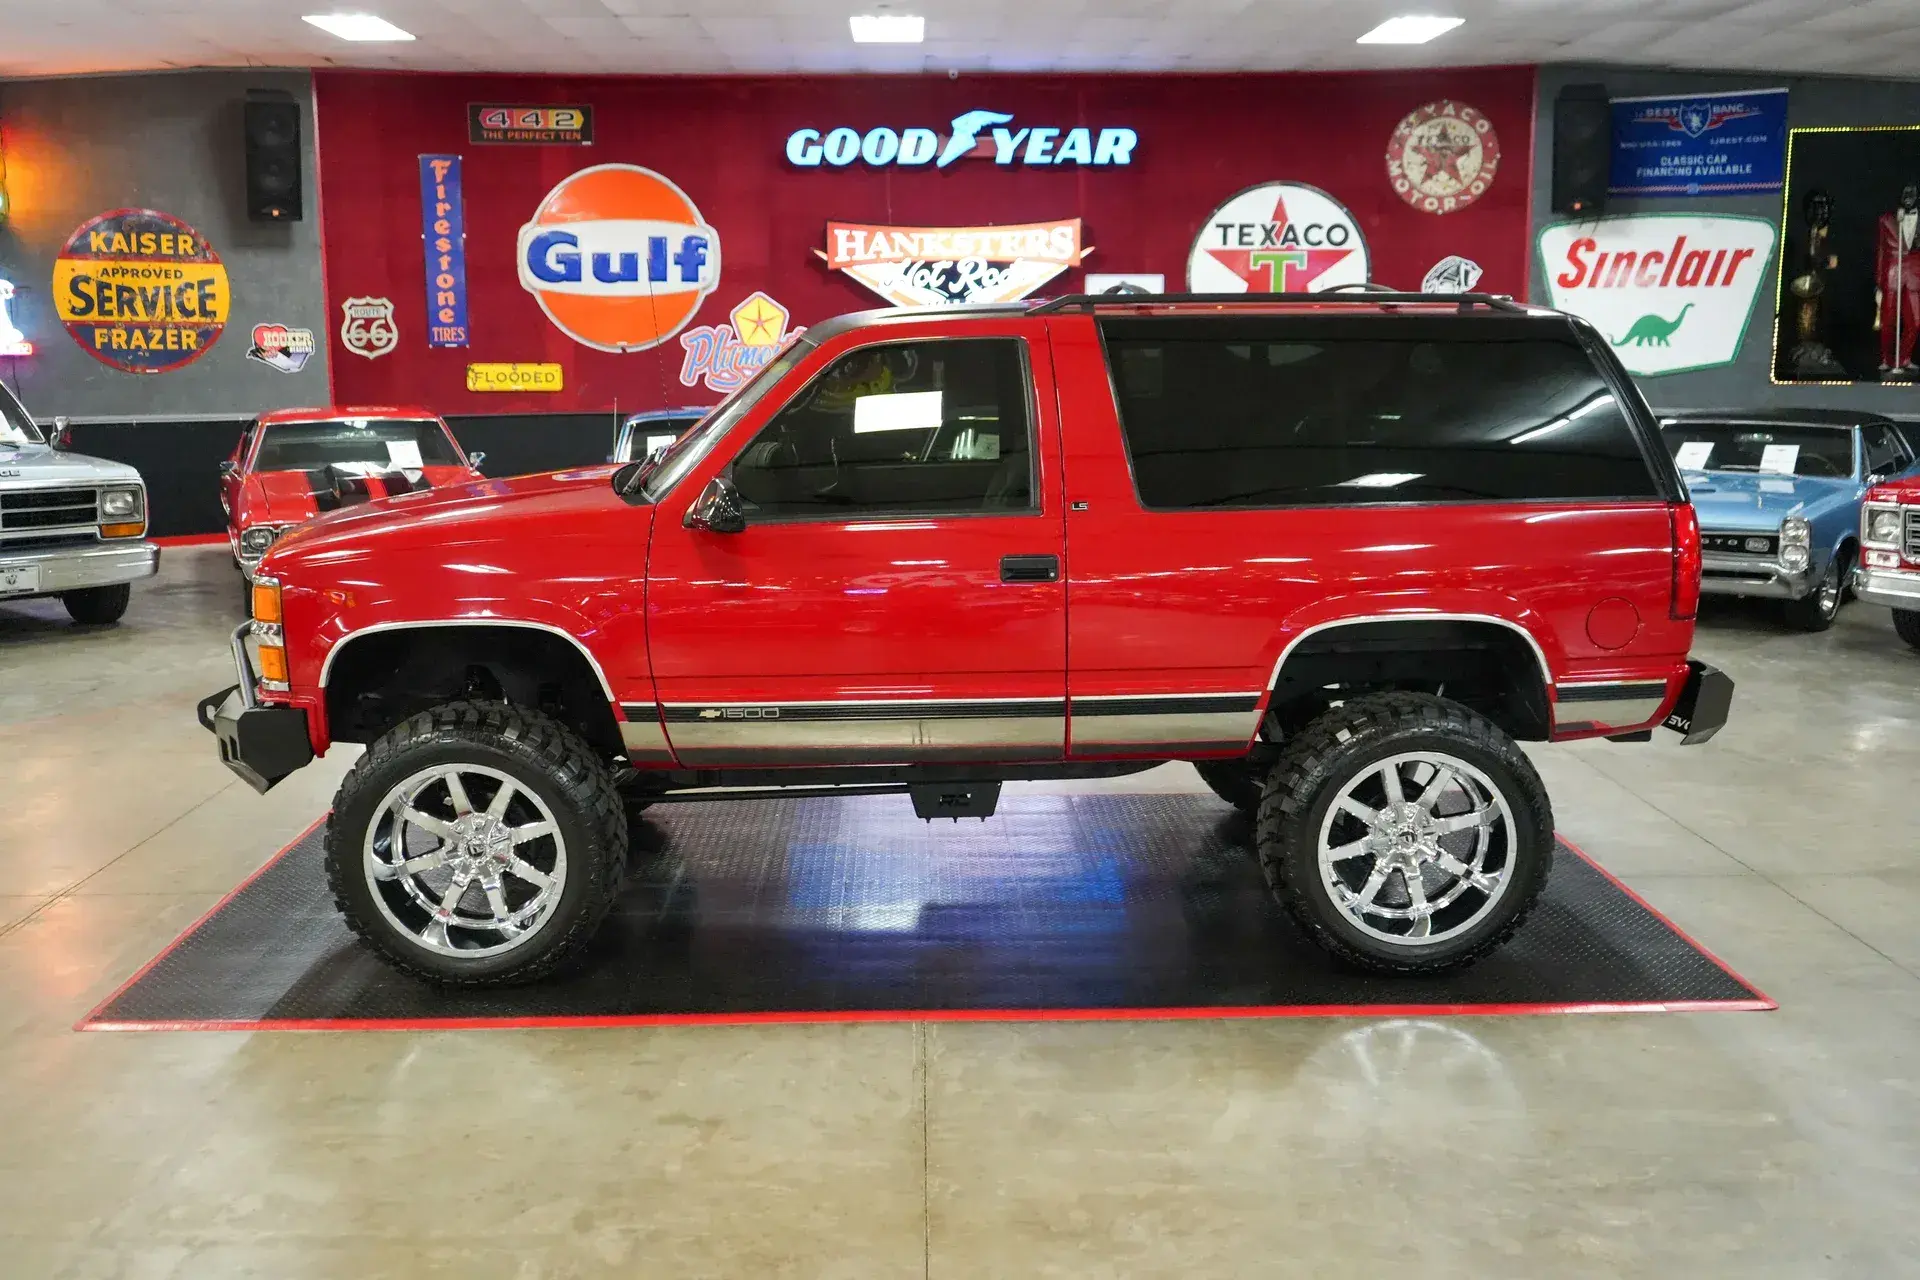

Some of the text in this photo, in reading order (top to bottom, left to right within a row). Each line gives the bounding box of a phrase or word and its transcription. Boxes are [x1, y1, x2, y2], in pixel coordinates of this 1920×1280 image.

[483, 130, 582, 140] THE PERFECT TEN
[992, 127, 1138, 165] YEAR
[1636, 163, 1752, 178] FINANCING AVAILABLE
[1660, 154, 1728, 167] CLASSIC CAR
[90, 231, 195, 256] KAISER
[429, 159, 456, 324] Firestone
[834, 226, 1074, 263] HANKSTERS
[1215, 223, 1349, 247] TEXACO
[526, 231, 709, 284] Gulf
[1557, 236, 1755, 290] Sinclair
[100, 267, 184, 280] APPROVED
[69, 274, 217, 318] SERVICE
[353, 308, 385, 316] ROUTE
[94, 327, 198, 350] FRAZER
[350, 319, 388, 347] 66
[432, 327, 466, 342] TIRES
[681, 332, 783, 387] Plymo
[474, 371, 555, 384] FLOODED
[1072, 502, 1088, 511] LS
[721, 707, 779, 719] 1500
